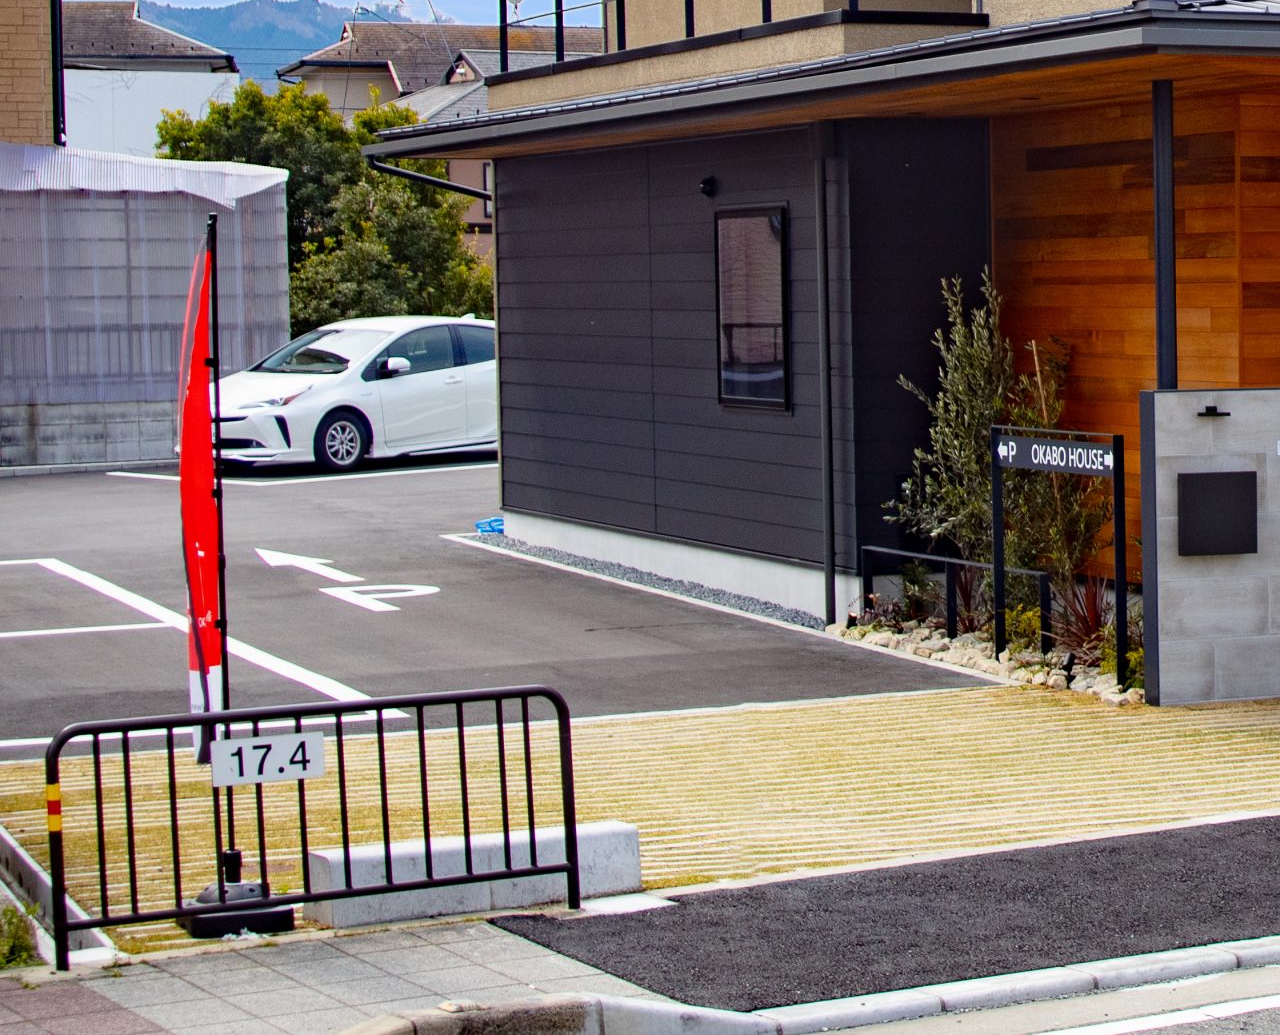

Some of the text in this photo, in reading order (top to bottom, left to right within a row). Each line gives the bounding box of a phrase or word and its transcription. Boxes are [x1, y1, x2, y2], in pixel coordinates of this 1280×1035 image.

[1008, 441, 1017, 463] P
[1031, 444, 1104, 470] OKABO HOUSE
[230, 740, 310, 777] 17.4
